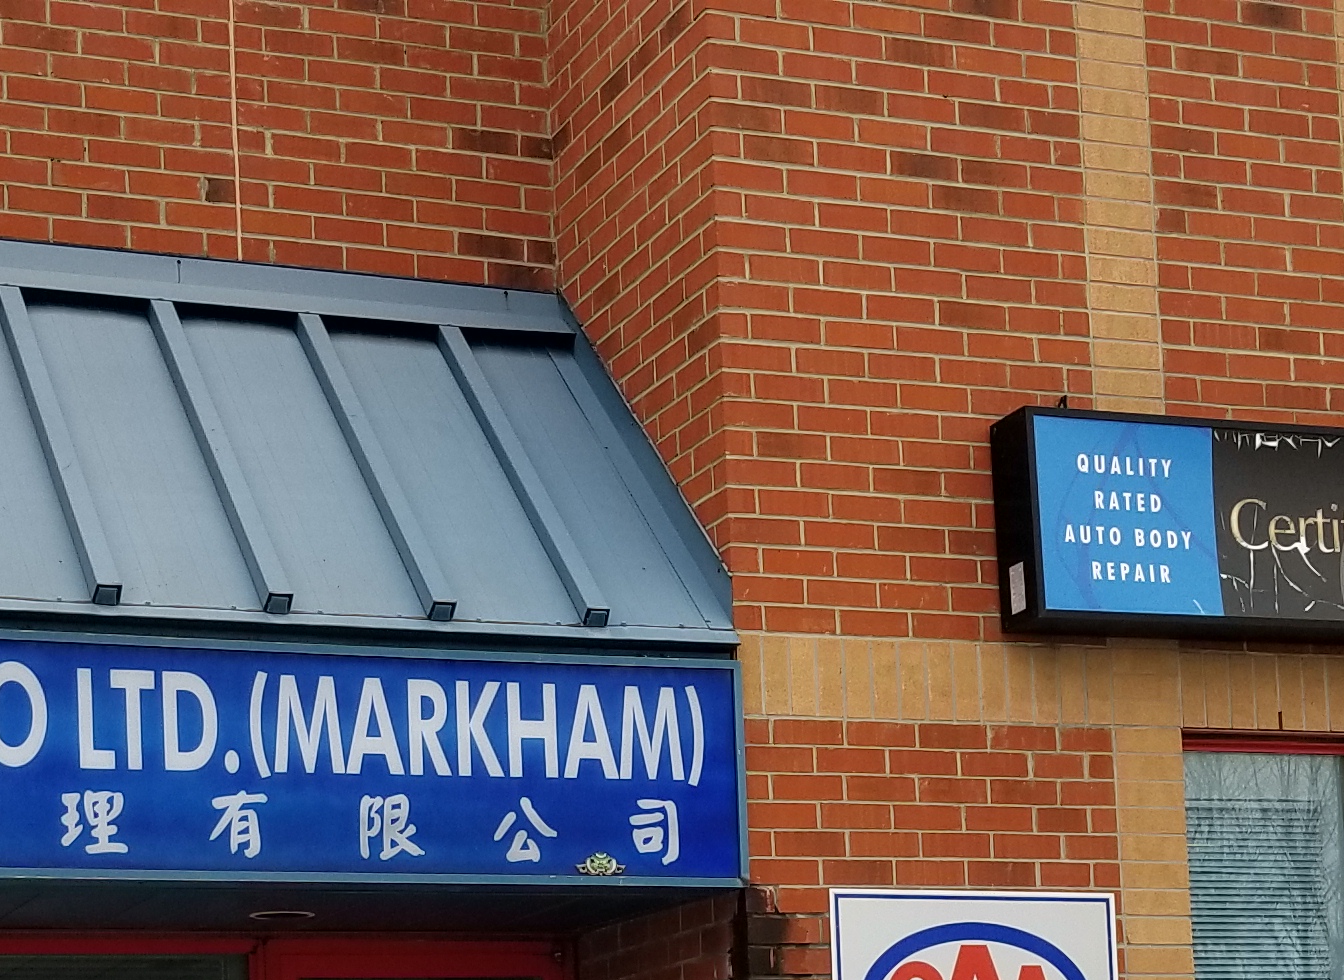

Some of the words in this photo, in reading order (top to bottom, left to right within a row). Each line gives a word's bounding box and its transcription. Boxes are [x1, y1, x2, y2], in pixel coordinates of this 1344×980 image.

[1076, 453, 1173, 478] QUALITY
[1094, 490, 1162, 513] RATED
[1064, 524, 1122, 546] AUTO
[1134, 528, 1193, 550] BODY
[1091, 561, 1172, 584] REPAIR
